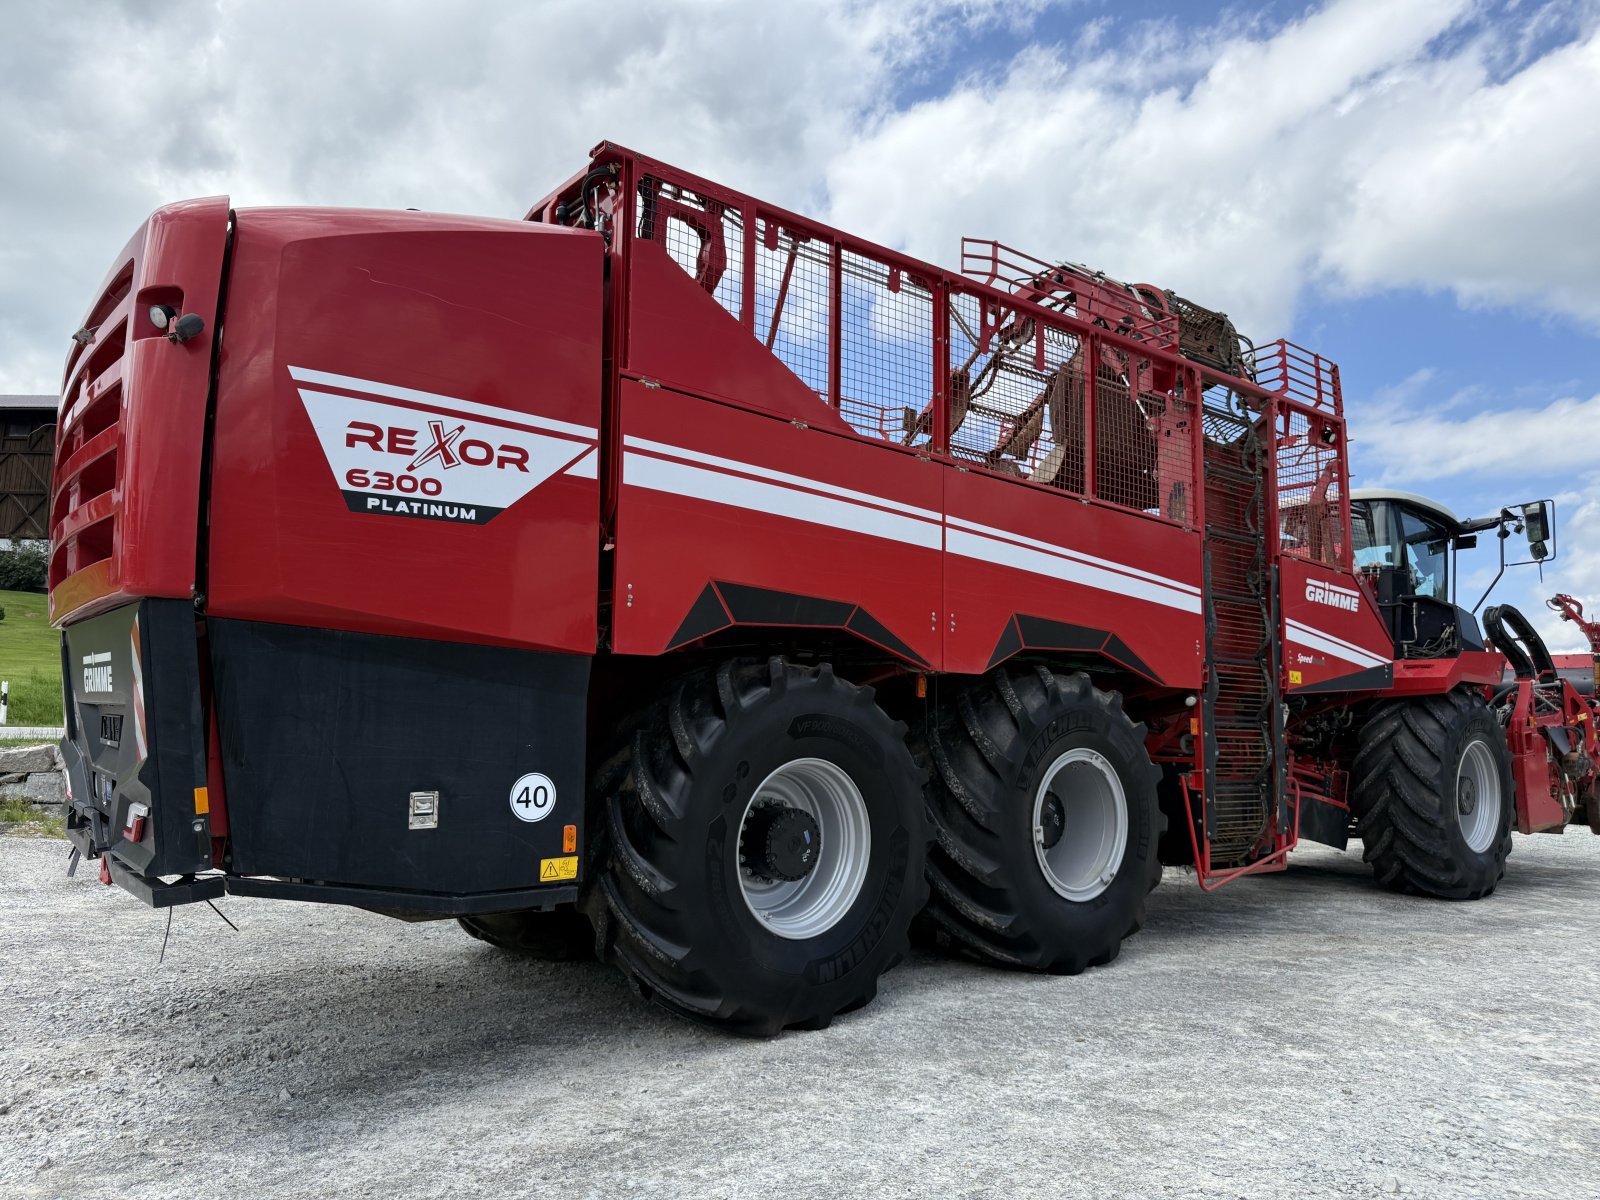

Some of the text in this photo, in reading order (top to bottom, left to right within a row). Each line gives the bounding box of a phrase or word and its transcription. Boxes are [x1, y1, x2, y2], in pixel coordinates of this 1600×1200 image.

[346, 420, 530, 473] REXOR
[345, 468, 442, 496] 6300
[367, 497, 476, 521] PLATINUM
[1305, 583, 1360, 613] GRIMME
[83, 661, 113, 693] GRIMME
[516, 785, 548, 809] 40
